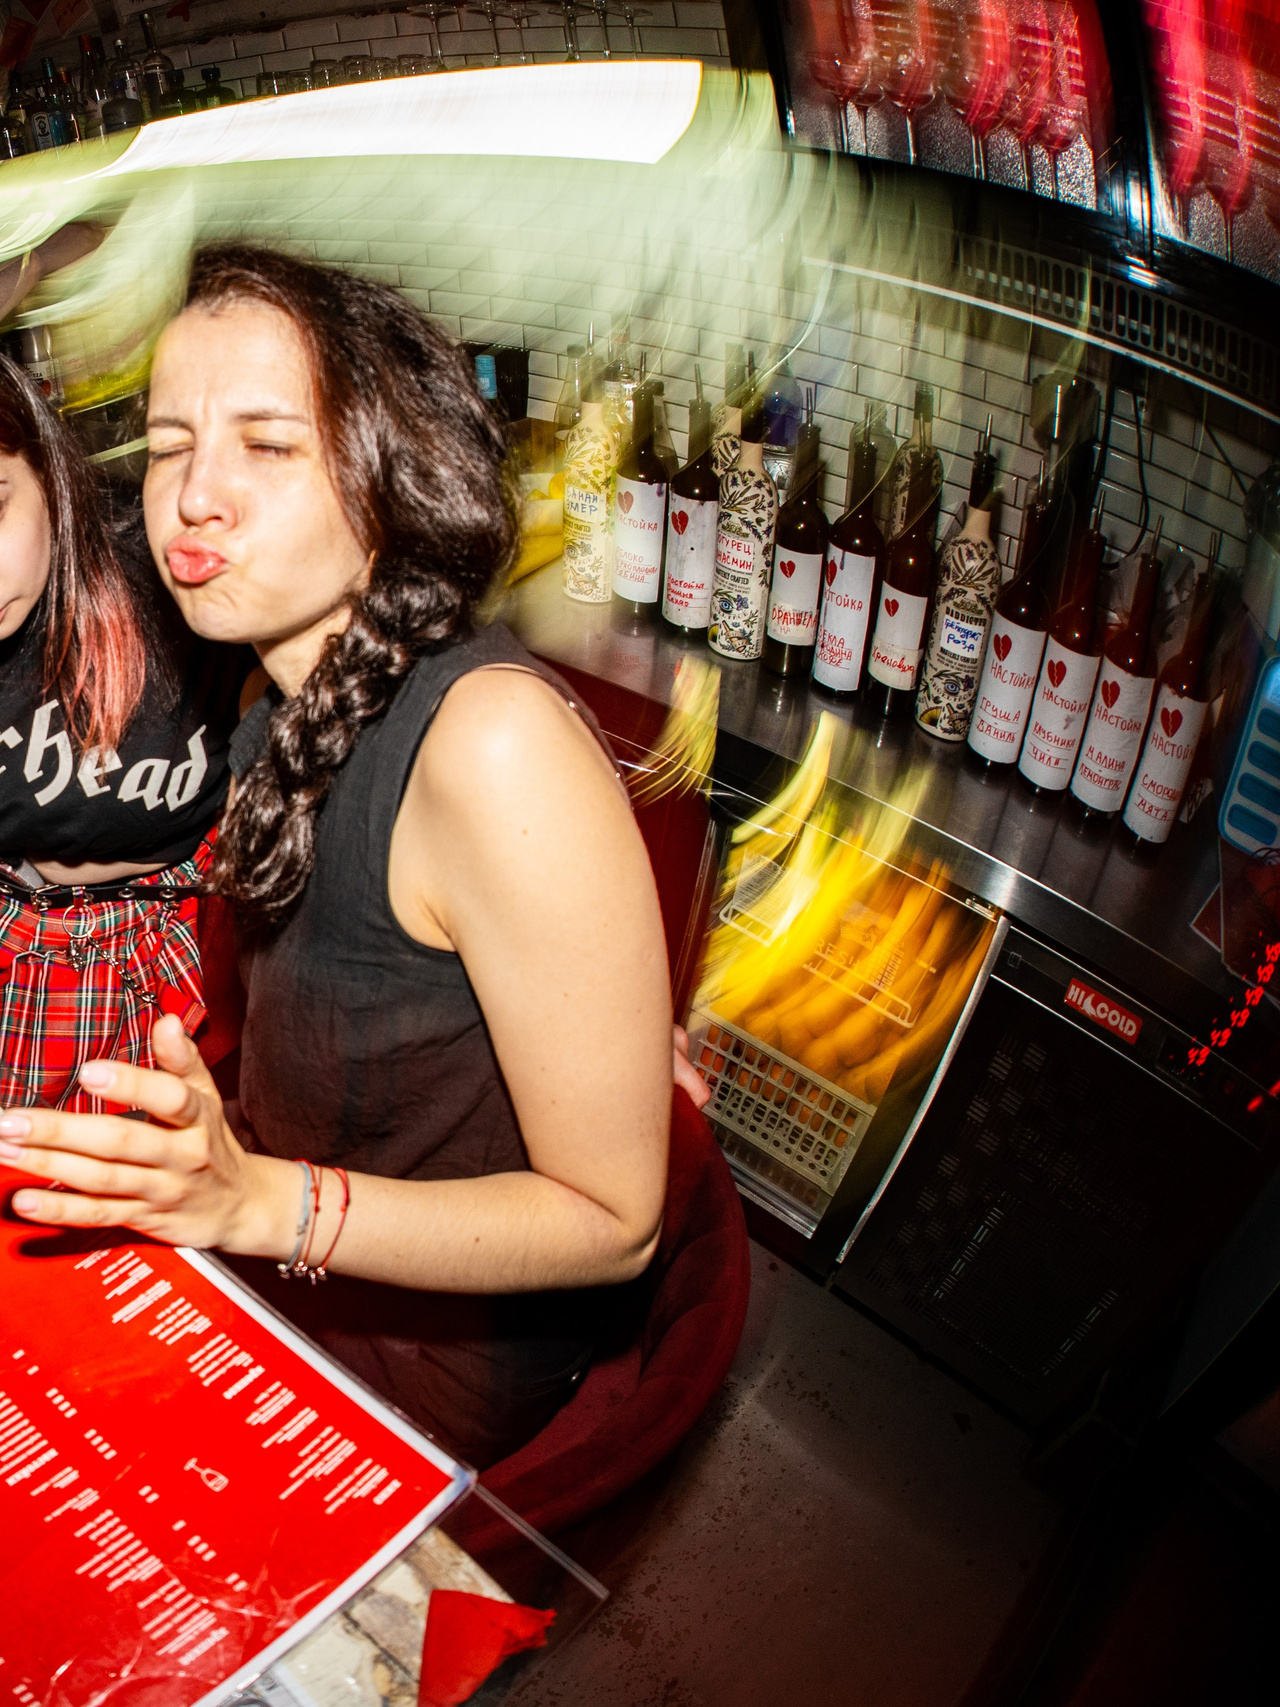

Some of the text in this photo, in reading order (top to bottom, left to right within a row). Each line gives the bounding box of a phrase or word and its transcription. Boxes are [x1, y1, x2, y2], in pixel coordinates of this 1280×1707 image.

[990, 659, 1036, 690] НАСТОЙКА
[979, 696, 1021, 722] ГРУША
[1042, 685, 1090, 714] НАСТОЙКА
[1094, 703, 1143, 734] НАСТОЙКА
[1085, 745, 1127, 772] МАЛИНА
